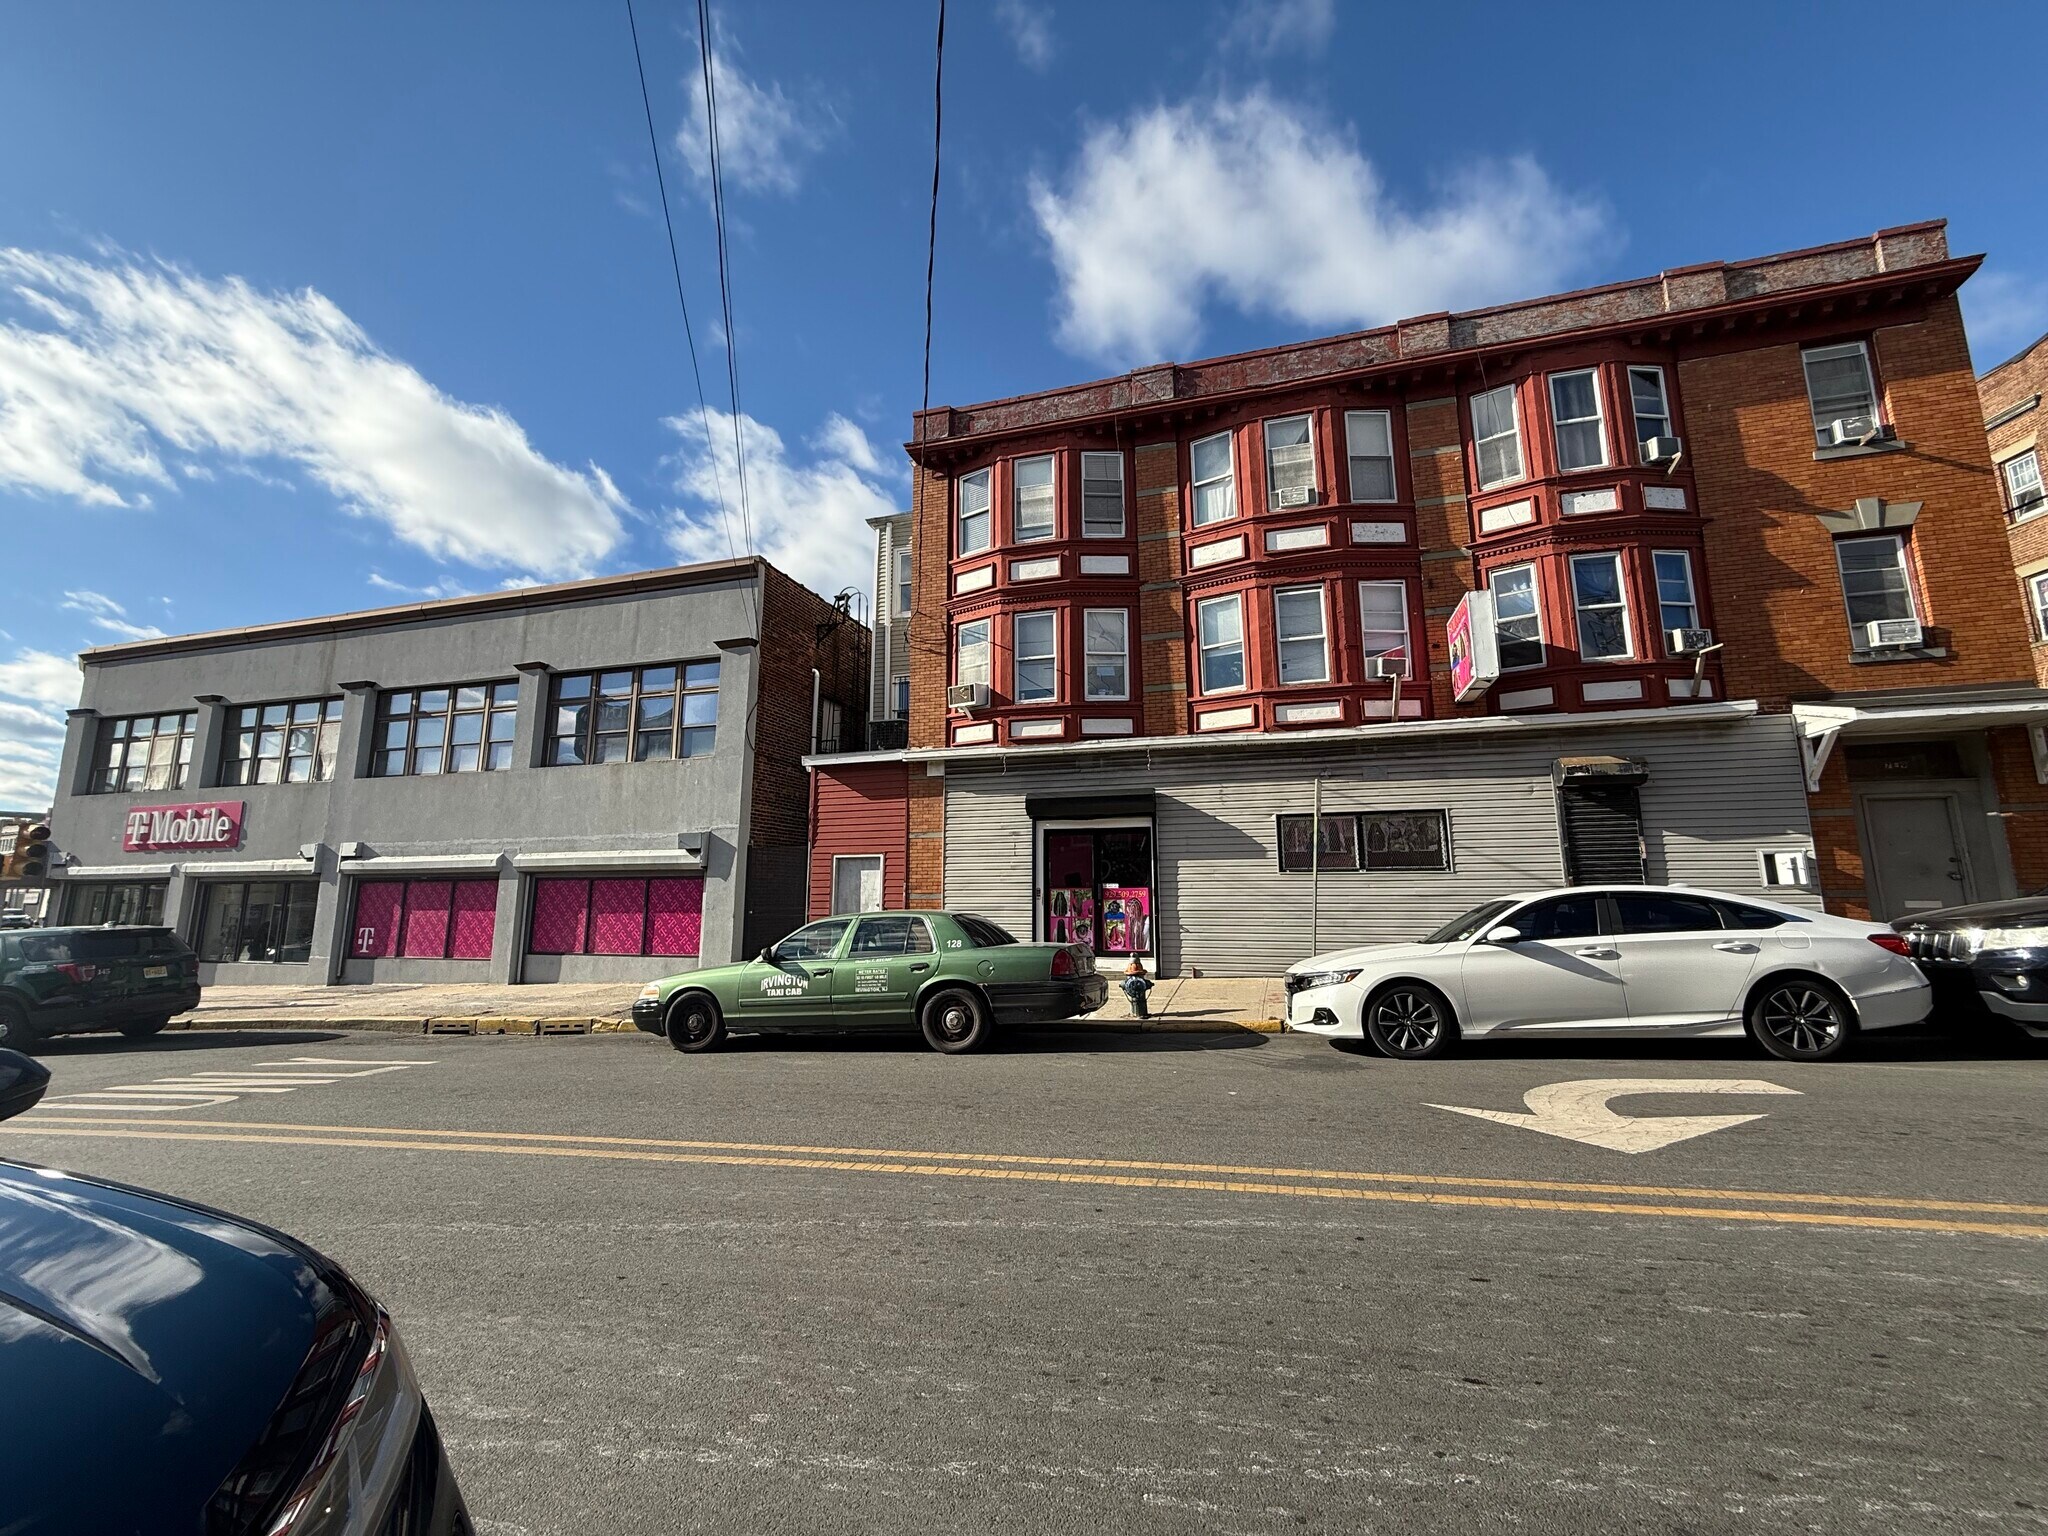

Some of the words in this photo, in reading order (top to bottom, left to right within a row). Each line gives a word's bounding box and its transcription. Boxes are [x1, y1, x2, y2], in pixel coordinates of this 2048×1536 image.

[357, 927, 375, 953] T
[946, 939, 962, 948] 128
[760, 974, 809, 991] IRVINGTON
[766, 988, 784, 997] TAXI
[785, 988, 802, 996] CAB
